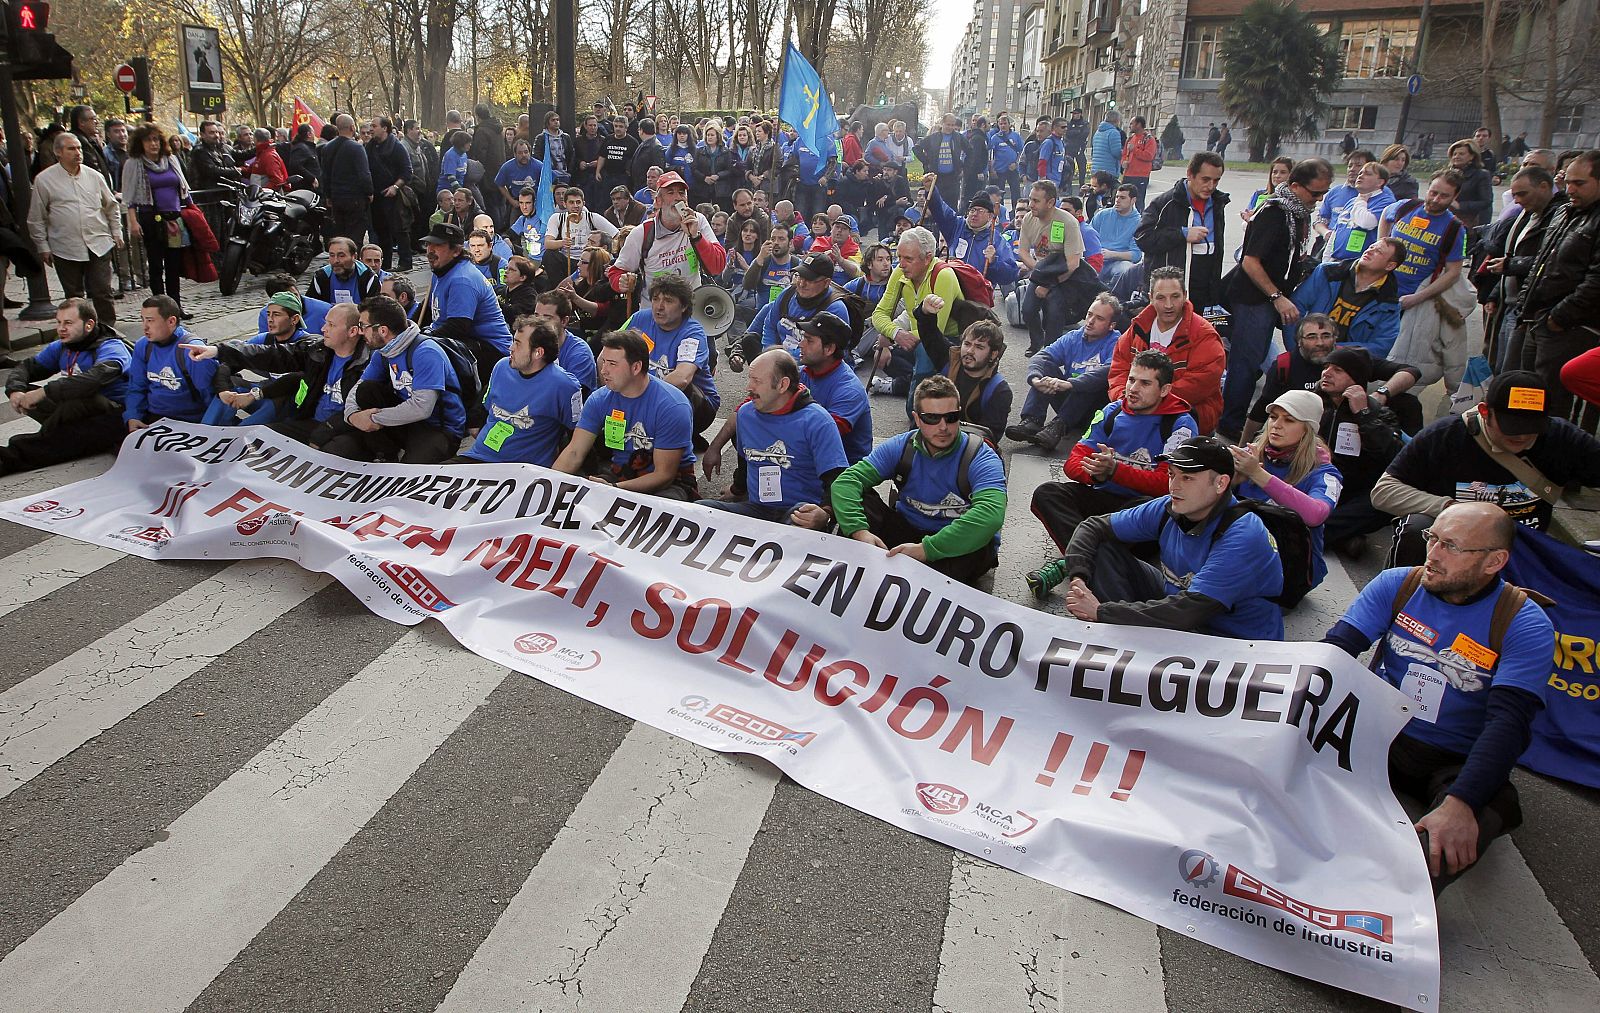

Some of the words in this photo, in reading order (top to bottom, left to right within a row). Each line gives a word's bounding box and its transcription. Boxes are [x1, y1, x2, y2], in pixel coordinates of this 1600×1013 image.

[1421, 231, 1442, 246] MELT
[346, 554, 392, 594] federación
[390, 593, 403, 605] de
[134, 425, 209, 453] POR
[192, 437, 240, 464] EL
[514, 478, 590, 530] DEL
[591, 497, 784, 583] EMPLEO
[781, 553, 865, 618] EN
[863, 574, 1024, 678] DURO
[1034, 637, 1360, 772] FELGUERA
[1397, 612, 1425, 633] CCOO
[559, 647, 585, 660] MCA
[462, 533, 626, 628] MELT,
[630, 582, 1016, 767] SOLUCIÓN
[1034, 731, 1146, 802] !!!
[1406, 670, 1419, 678] DURO
[1418, 672, 1443, 686] FELGUERA
[666, 707, 727, 735] federación
[727, 732, 744, 742] de
[744, 737, 798, 756] industria
[714, 708, 783, 739] CCOO
[921, 785, 965, 806] UGT
[970, 810, 1017, 832] Asturias
[975, 803, 1014, 825] MCA
[1234, 872, 1338, 926] CCOO
[1172, 888, 1268, 928] federación
[1273, 917, 1296, 936] de
[1301, 925, 1394, 964] industria
